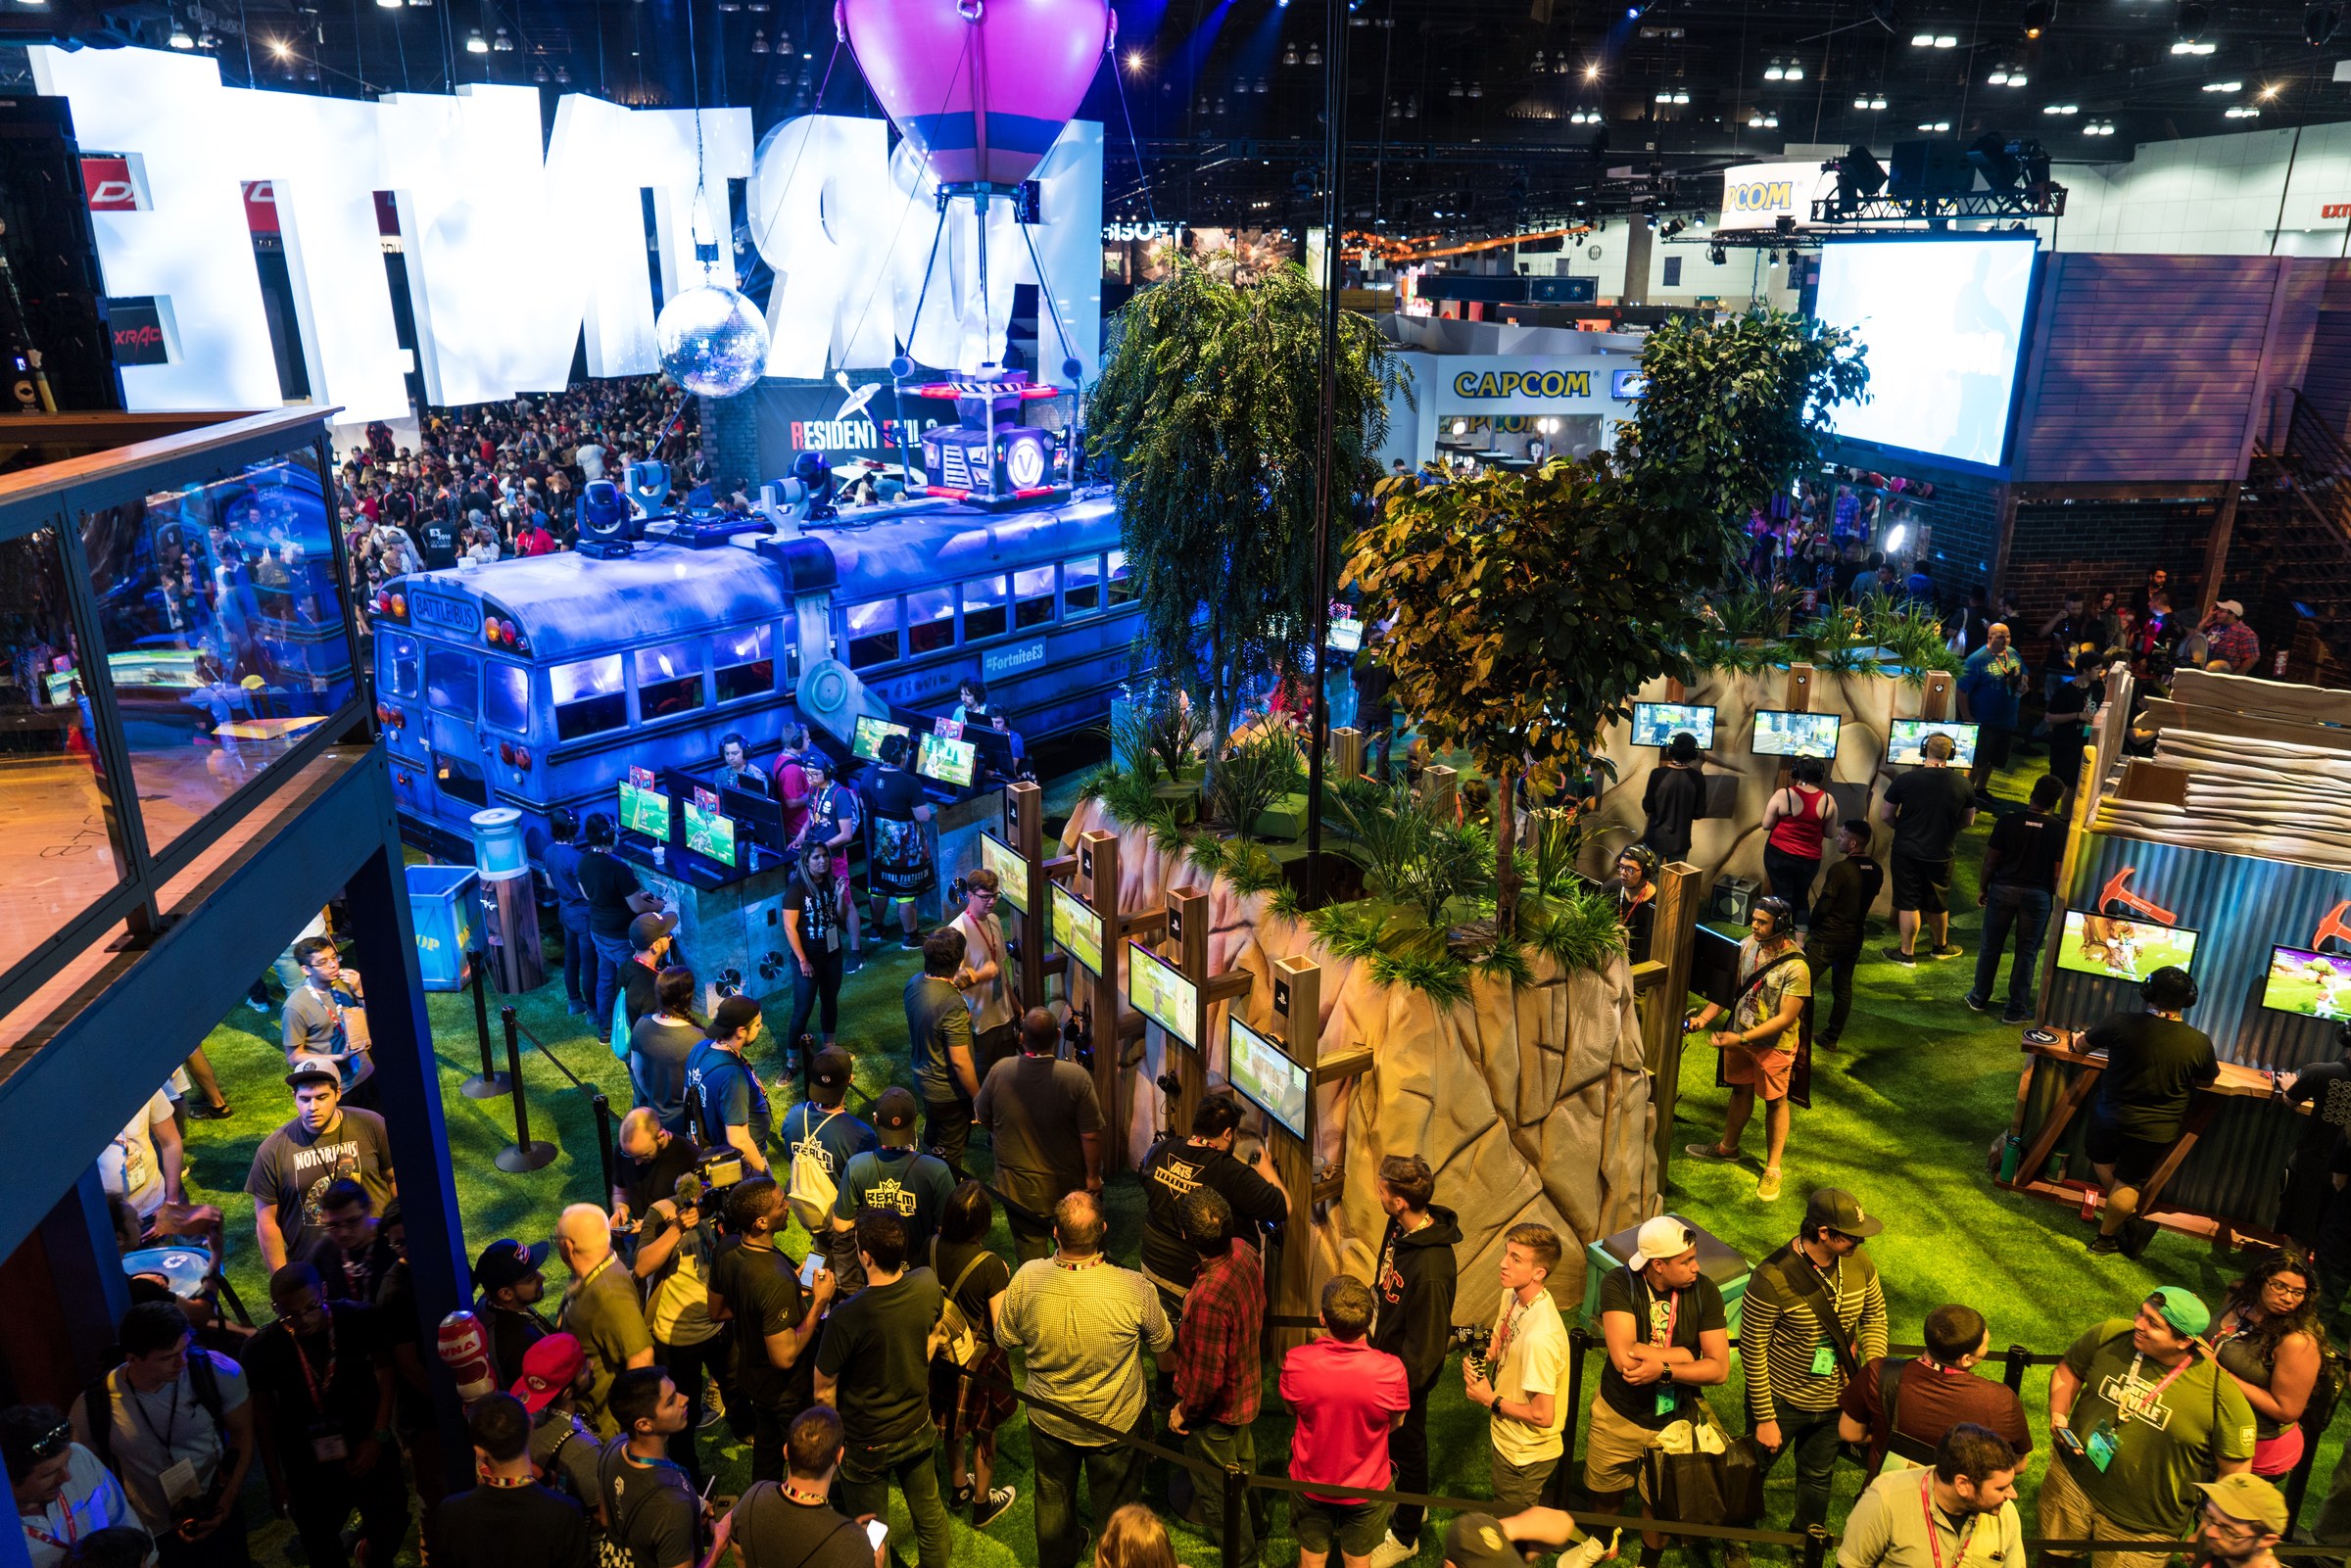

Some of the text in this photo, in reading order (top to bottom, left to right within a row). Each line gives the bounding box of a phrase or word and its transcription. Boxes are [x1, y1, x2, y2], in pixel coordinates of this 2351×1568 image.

[1725, 181, 1792, 214] PCOM
[2322, 204, 2351, 218] EXI
[115, 325, 163, 354] XRAC
[1454, 370, 1591, 399] CAPCOM
[791, 419, 877, 451] RESIDENT
[414, 595, 474, 628] BATTLE BUS
[985, 643, 1043, 673] #FortniteE3
[2130, 898, 2153, 913] FORTNITE
[792, 1143, 833, 1165] REALM
[866, 1188, 915, 1207] REALM
